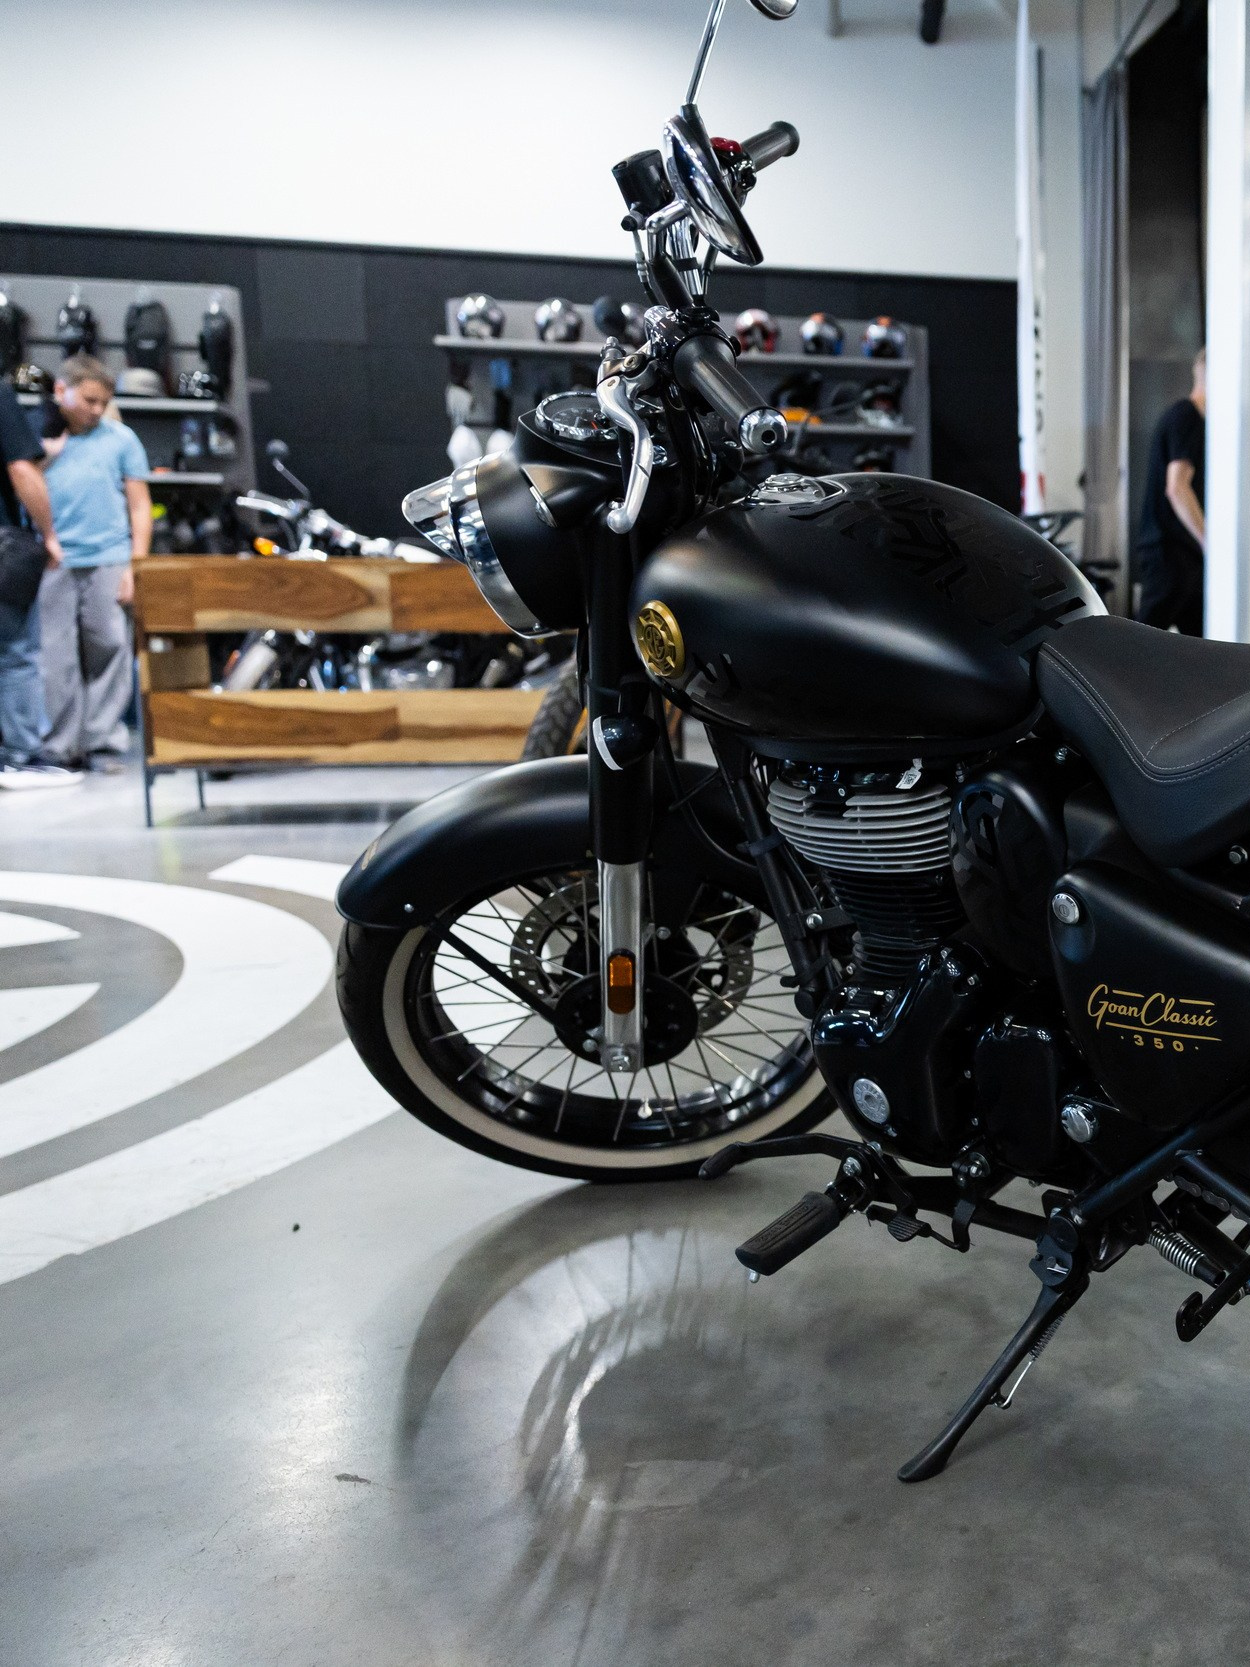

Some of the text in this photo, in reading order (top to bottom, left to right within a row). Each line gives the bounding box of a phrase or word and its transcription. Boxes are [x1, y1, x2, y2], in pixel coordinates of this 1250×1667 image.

[1087, 983, 1218, 1030] Goan Classic
[1133, 1034, 1185, 1052] 350
